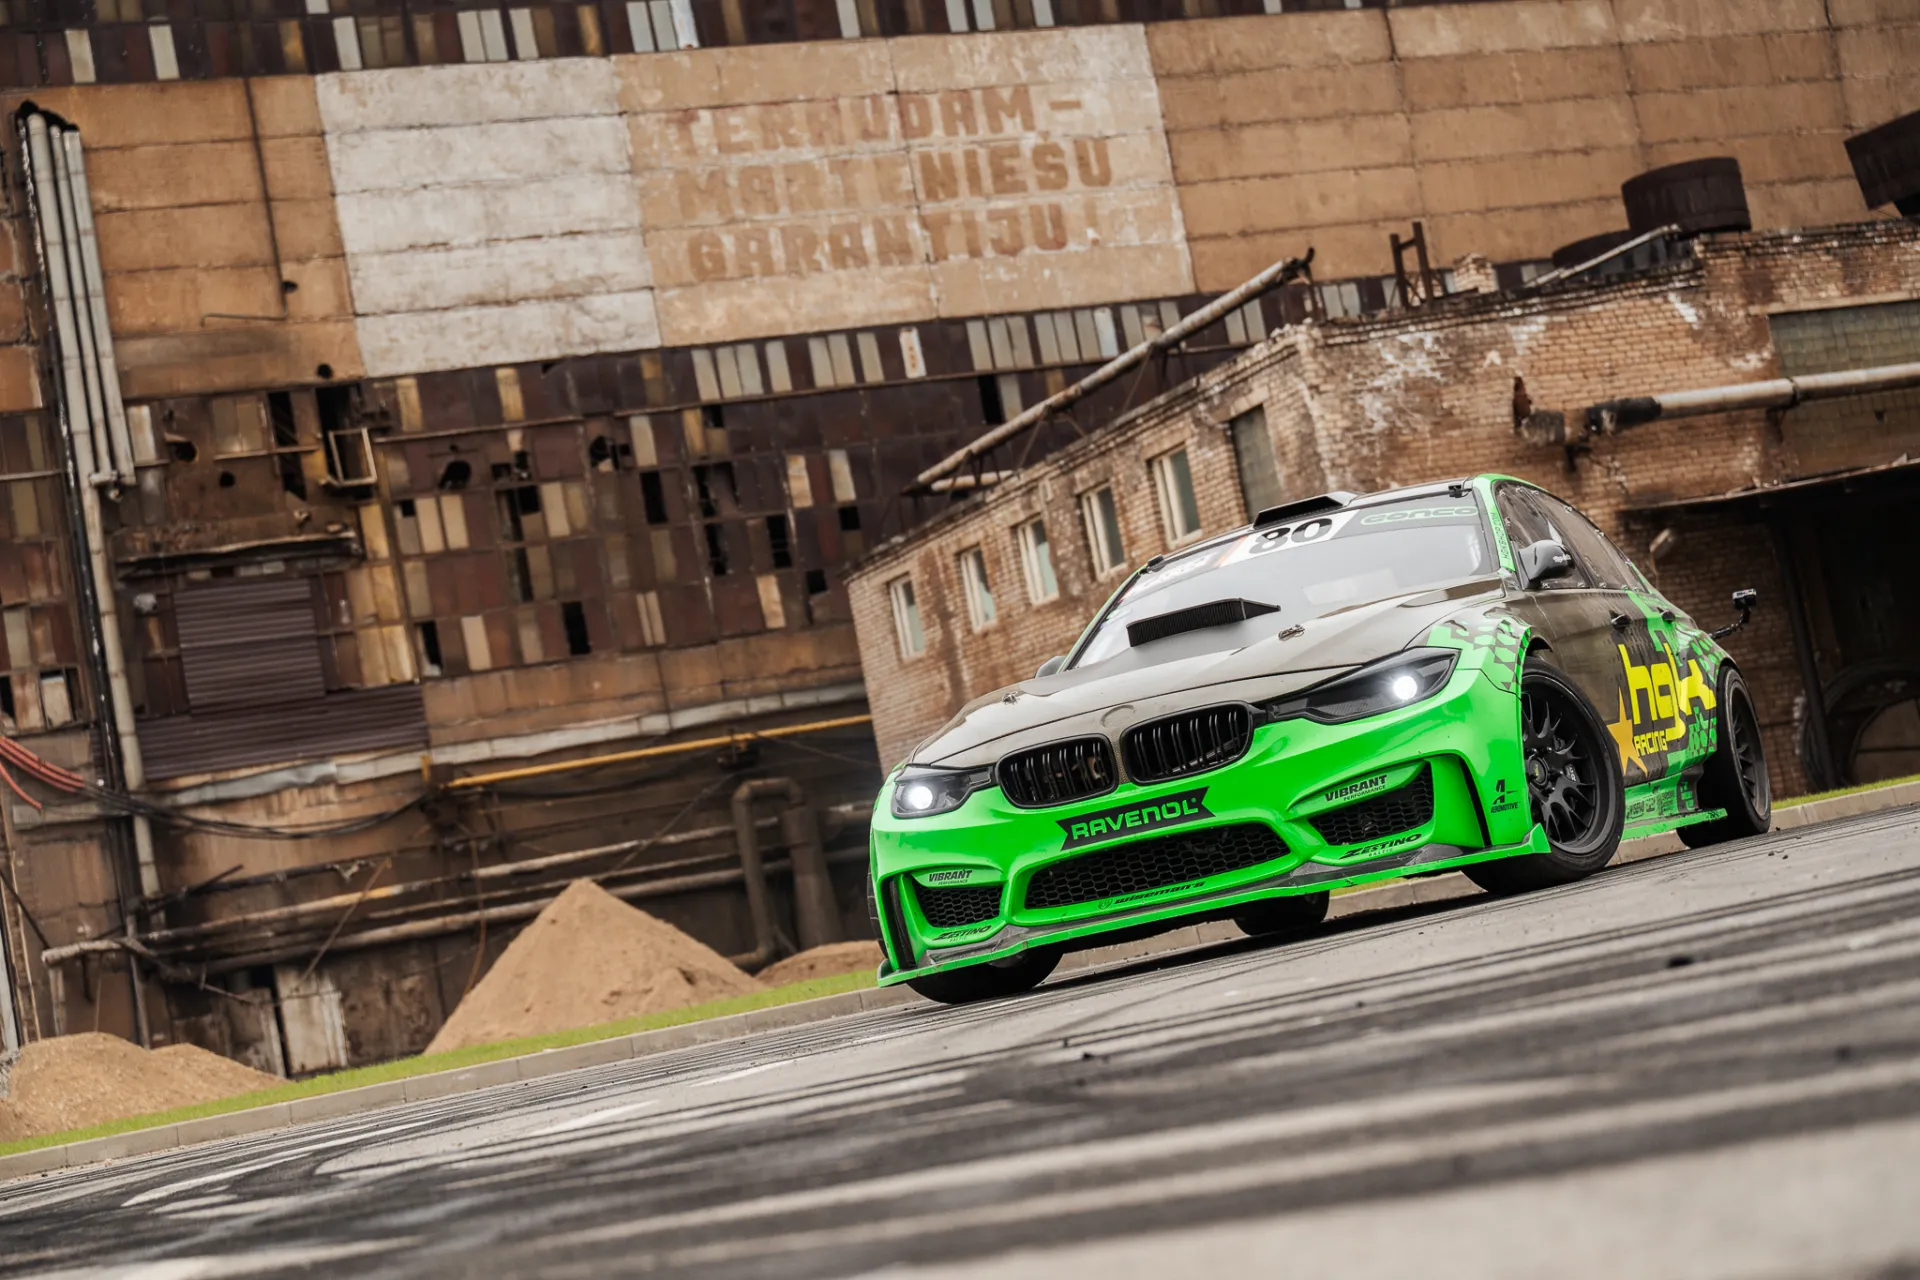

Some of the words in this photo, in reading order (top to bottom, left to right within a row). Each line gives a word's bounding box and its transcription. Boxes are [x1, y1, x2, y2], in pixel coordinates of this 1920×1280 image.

[1249, 518, 1333, 553] 80
[1634, 730, 1668, 757] RACING
[1325, 775, 1387, 802] VIBRANT
[1344, 785, 1386, 801] PERFORMANCE
[1339, 834, 1422, 860] ZESTINO
[929, 869, 972, 882] VIBRANT
